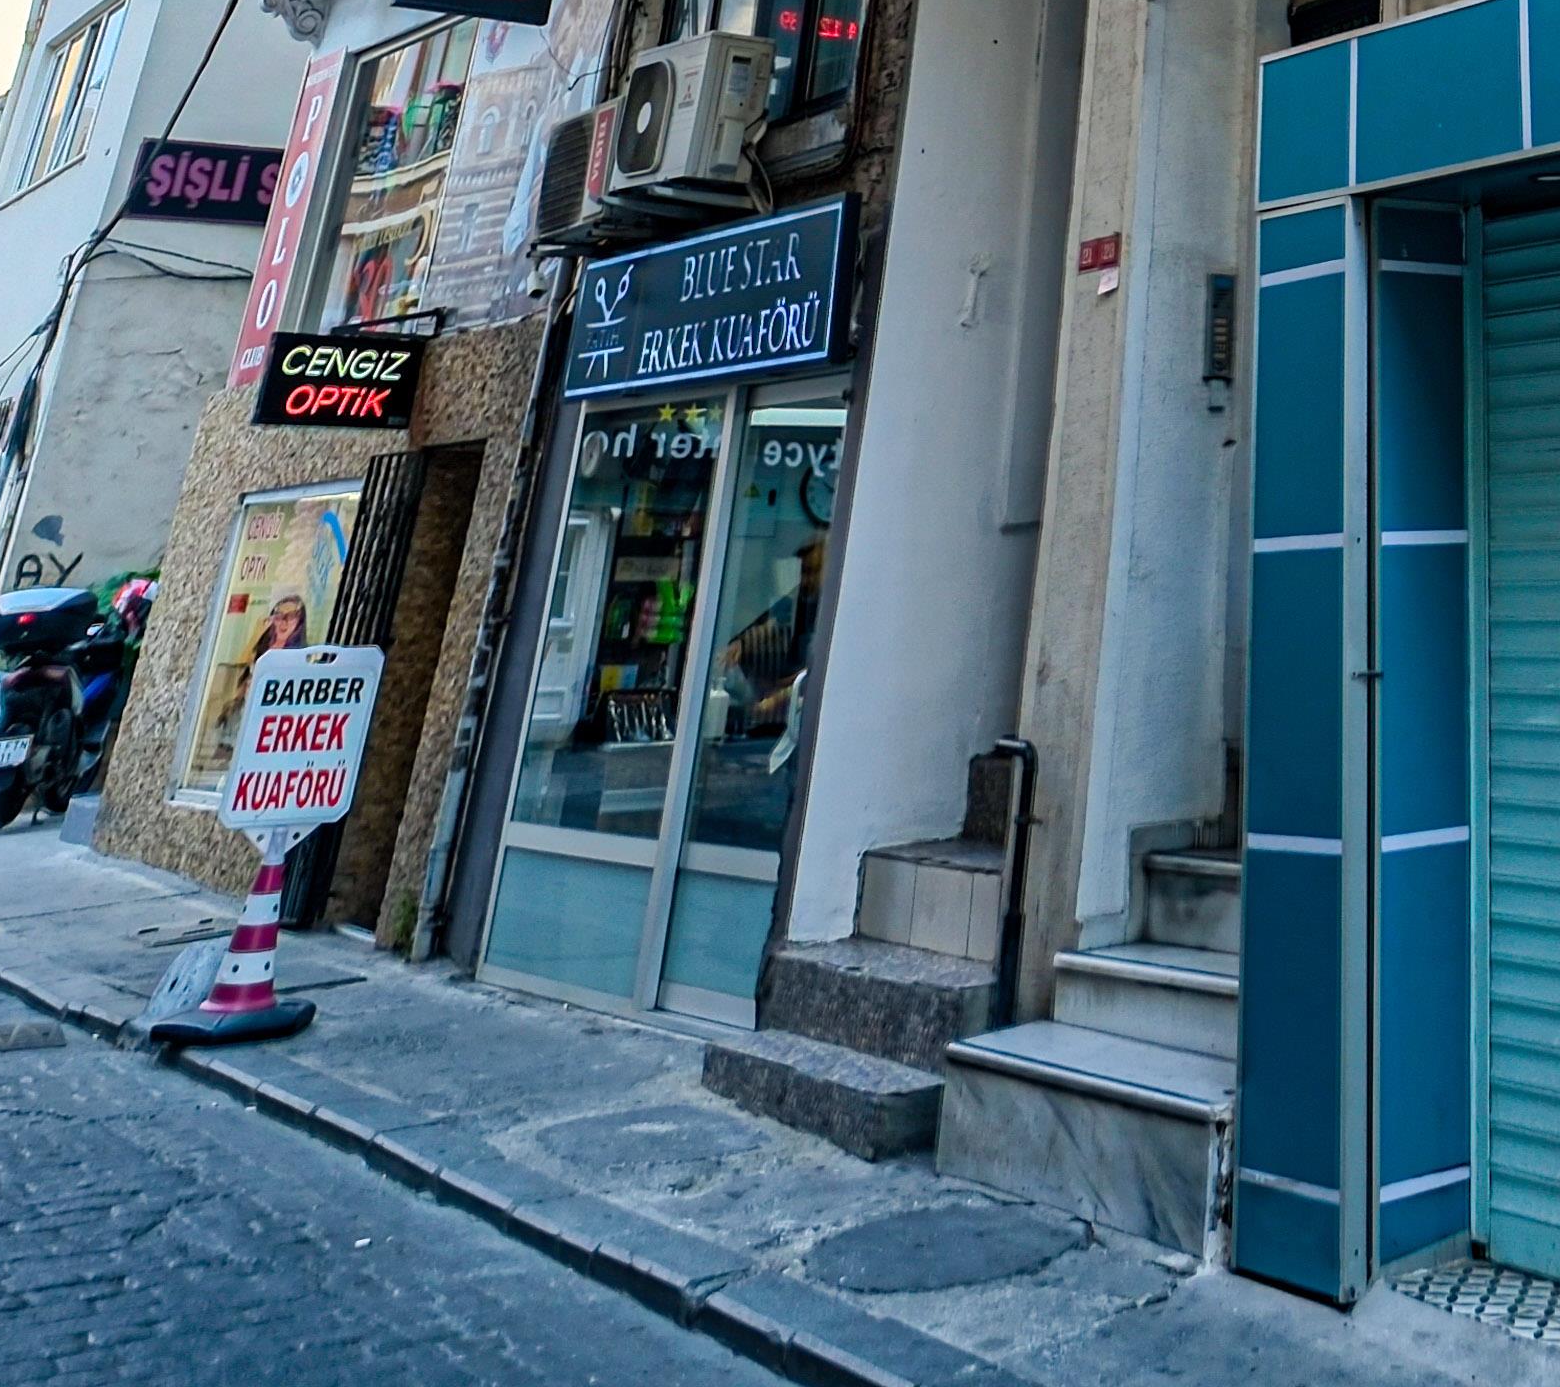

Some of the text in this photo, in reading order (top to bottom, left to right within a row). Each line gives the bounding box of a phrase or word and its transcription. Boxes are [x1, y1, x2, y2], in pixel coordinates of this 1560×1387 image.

[145, 150, 252, 209] ŞİŞLİ
[255, 93, 324, 331] POLO
[680, 232, 801, 303] BLUE STAR
[637, 291, 821, 375] ERKEK KUAFÖRÜ
[261, 677, 365, 707] BARBER
[255, 713, 352, 754] ERKEK
[232, 759, 348, 812] KUAFÖRÜ
